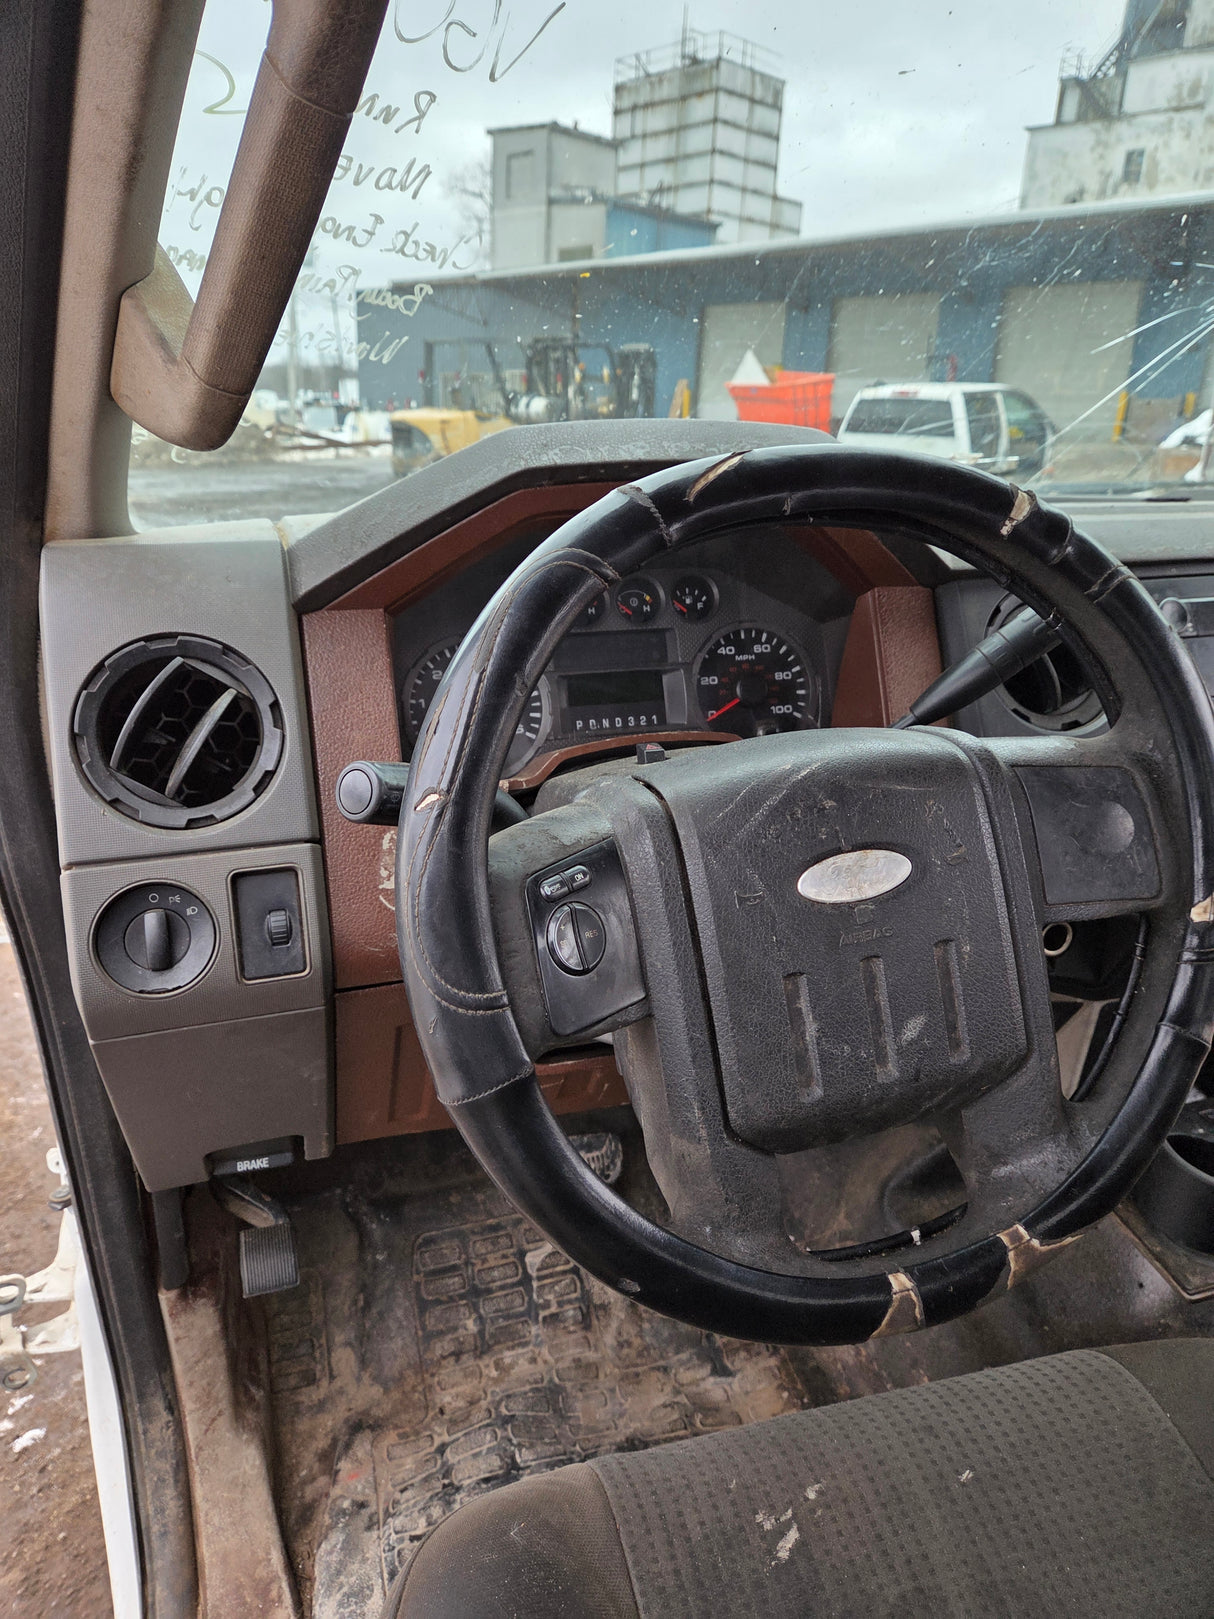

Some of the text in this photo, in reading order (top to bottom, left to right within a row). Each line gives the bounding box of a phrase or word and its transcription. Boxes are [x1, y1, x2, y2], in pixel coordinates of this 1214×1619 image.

[717, 644, 770, 655] 40 60
[700, 676, 718, 685] 20
[775, 671, 792, 680] 80
[770, 705, 793, 714] 100
[576, 720, 583, 731] P
[602, 718, 610, 728] N
[615, 717, 622, 727] D
[628, 716, 635, 726] 3
[640, 715, 647, 725] 2
[652, 714, 658, 724] 1
[574, 872, 584, 881] ON
[237, 1157, 269, 1171] BRAKE
